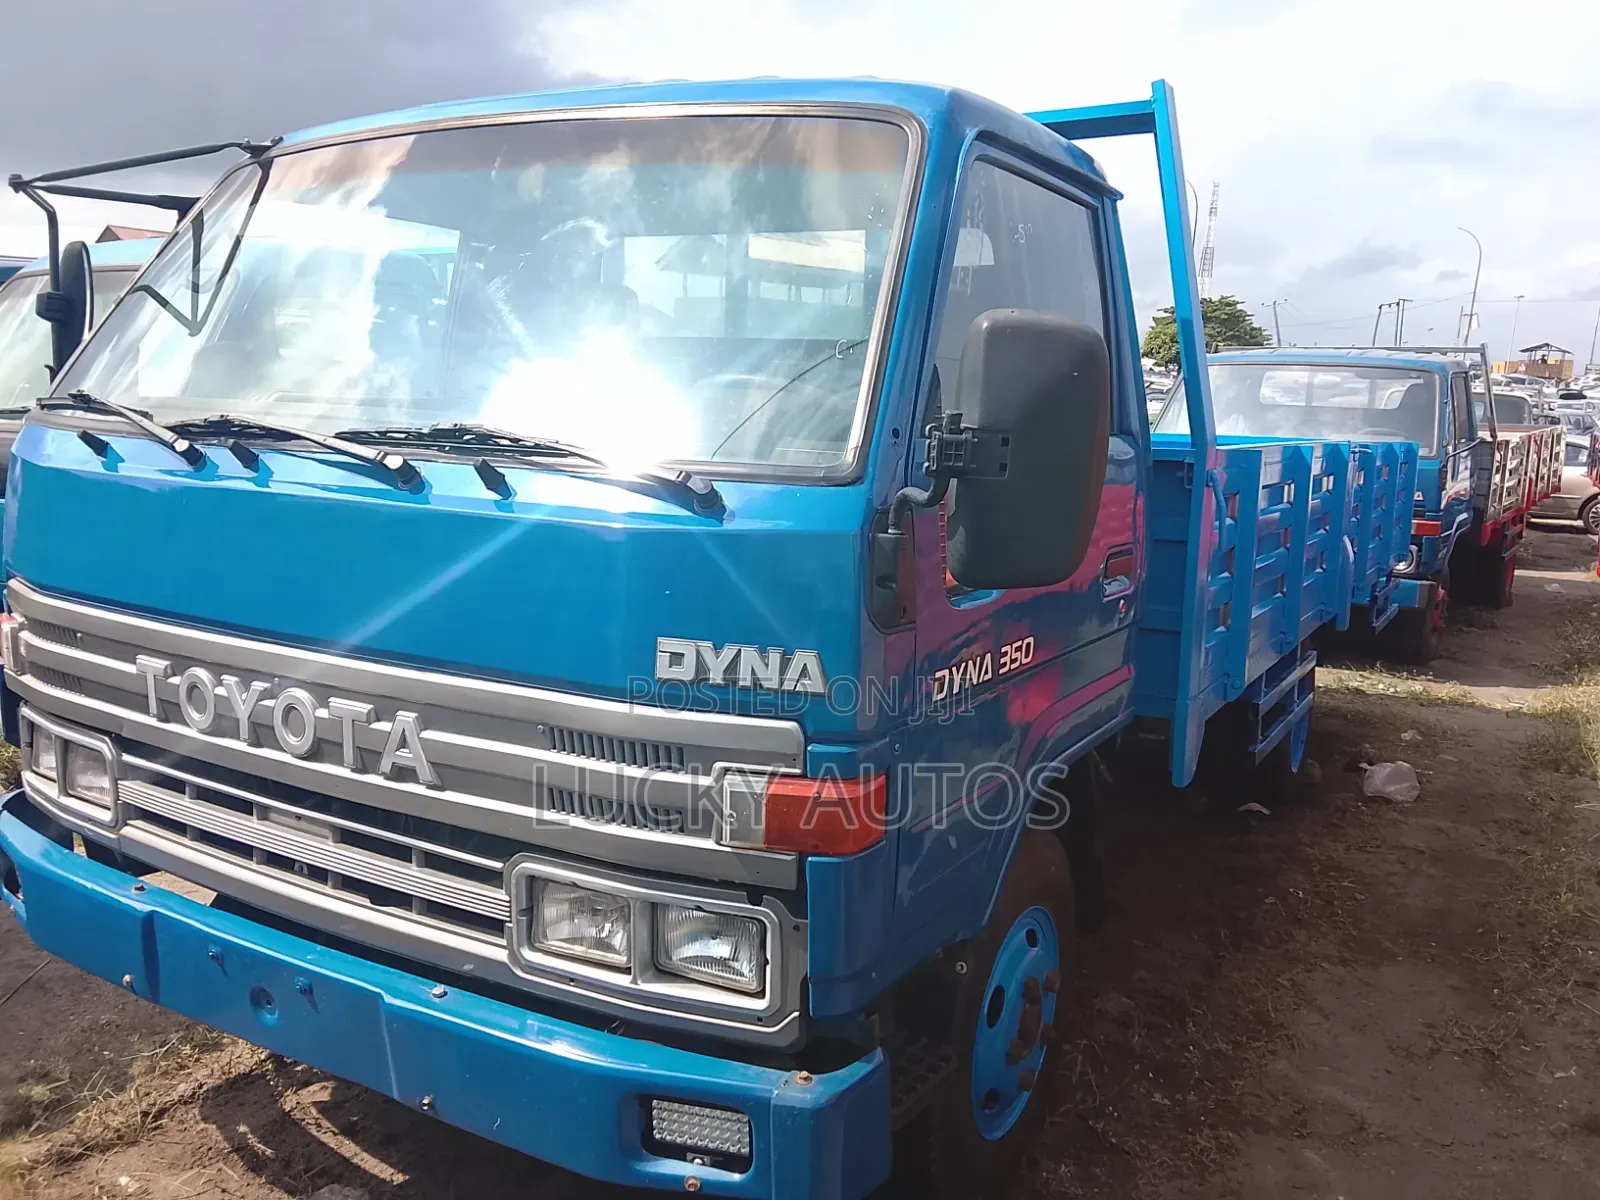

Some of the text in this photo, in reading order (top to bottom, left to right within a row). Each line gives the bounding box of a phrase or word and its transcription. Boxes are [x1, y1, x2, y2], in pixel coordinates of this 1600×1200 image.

[656, 637, 827, 694] DYNA
[932, 635, 1035, 703] DYNA 350
[135, 654, 444, 790] TOYOTA
